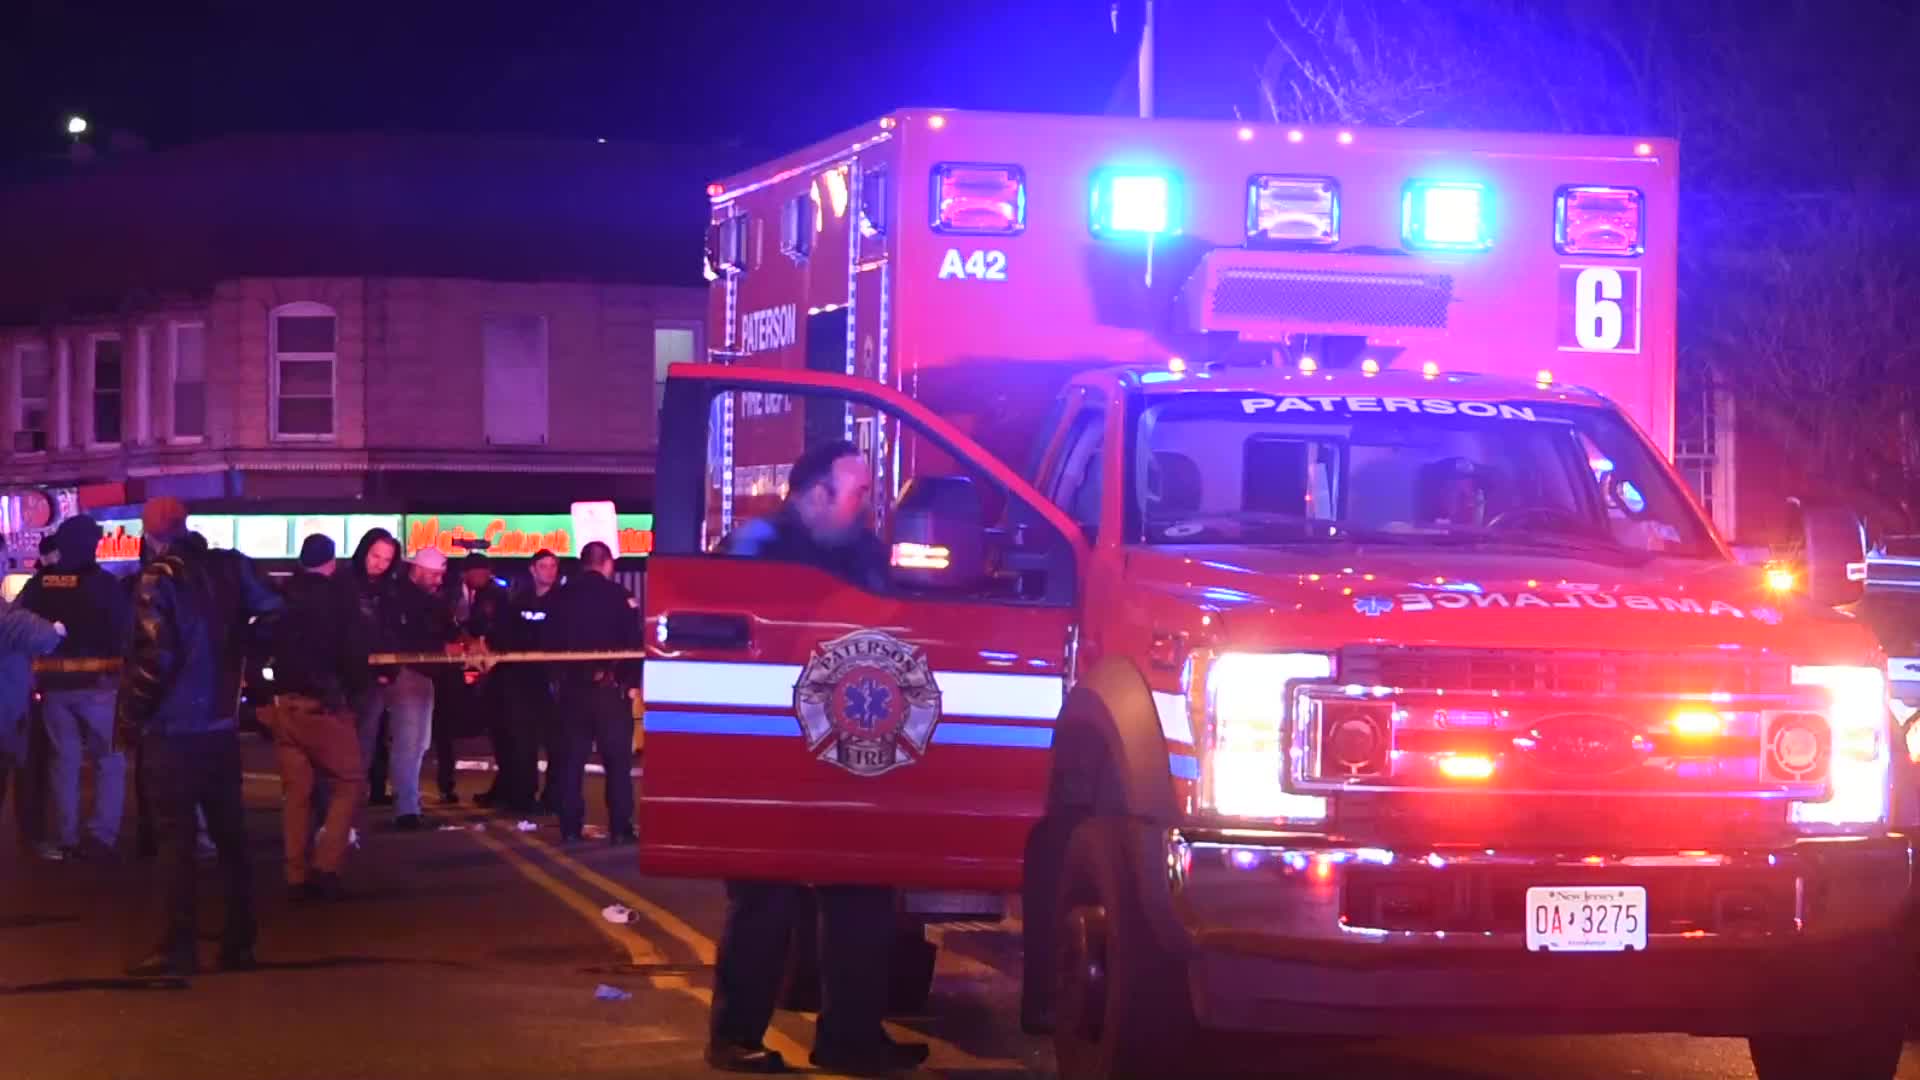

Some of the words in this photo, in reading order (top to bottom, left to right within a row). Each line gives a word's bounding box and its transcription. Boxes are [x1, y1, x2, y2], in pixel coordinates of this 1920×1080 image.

[938, 248, 1006, 279] A42
[1575, 267, 1622, 350] 6
[741, 303, 797, 353] PATERSON
[1240, 396, 1537, 422] PATERSON
[820, 640, 915, 673] PATERSON
[845, 750, 888, 766] FIRE
[1582, 905, 1639, 934] 3275
